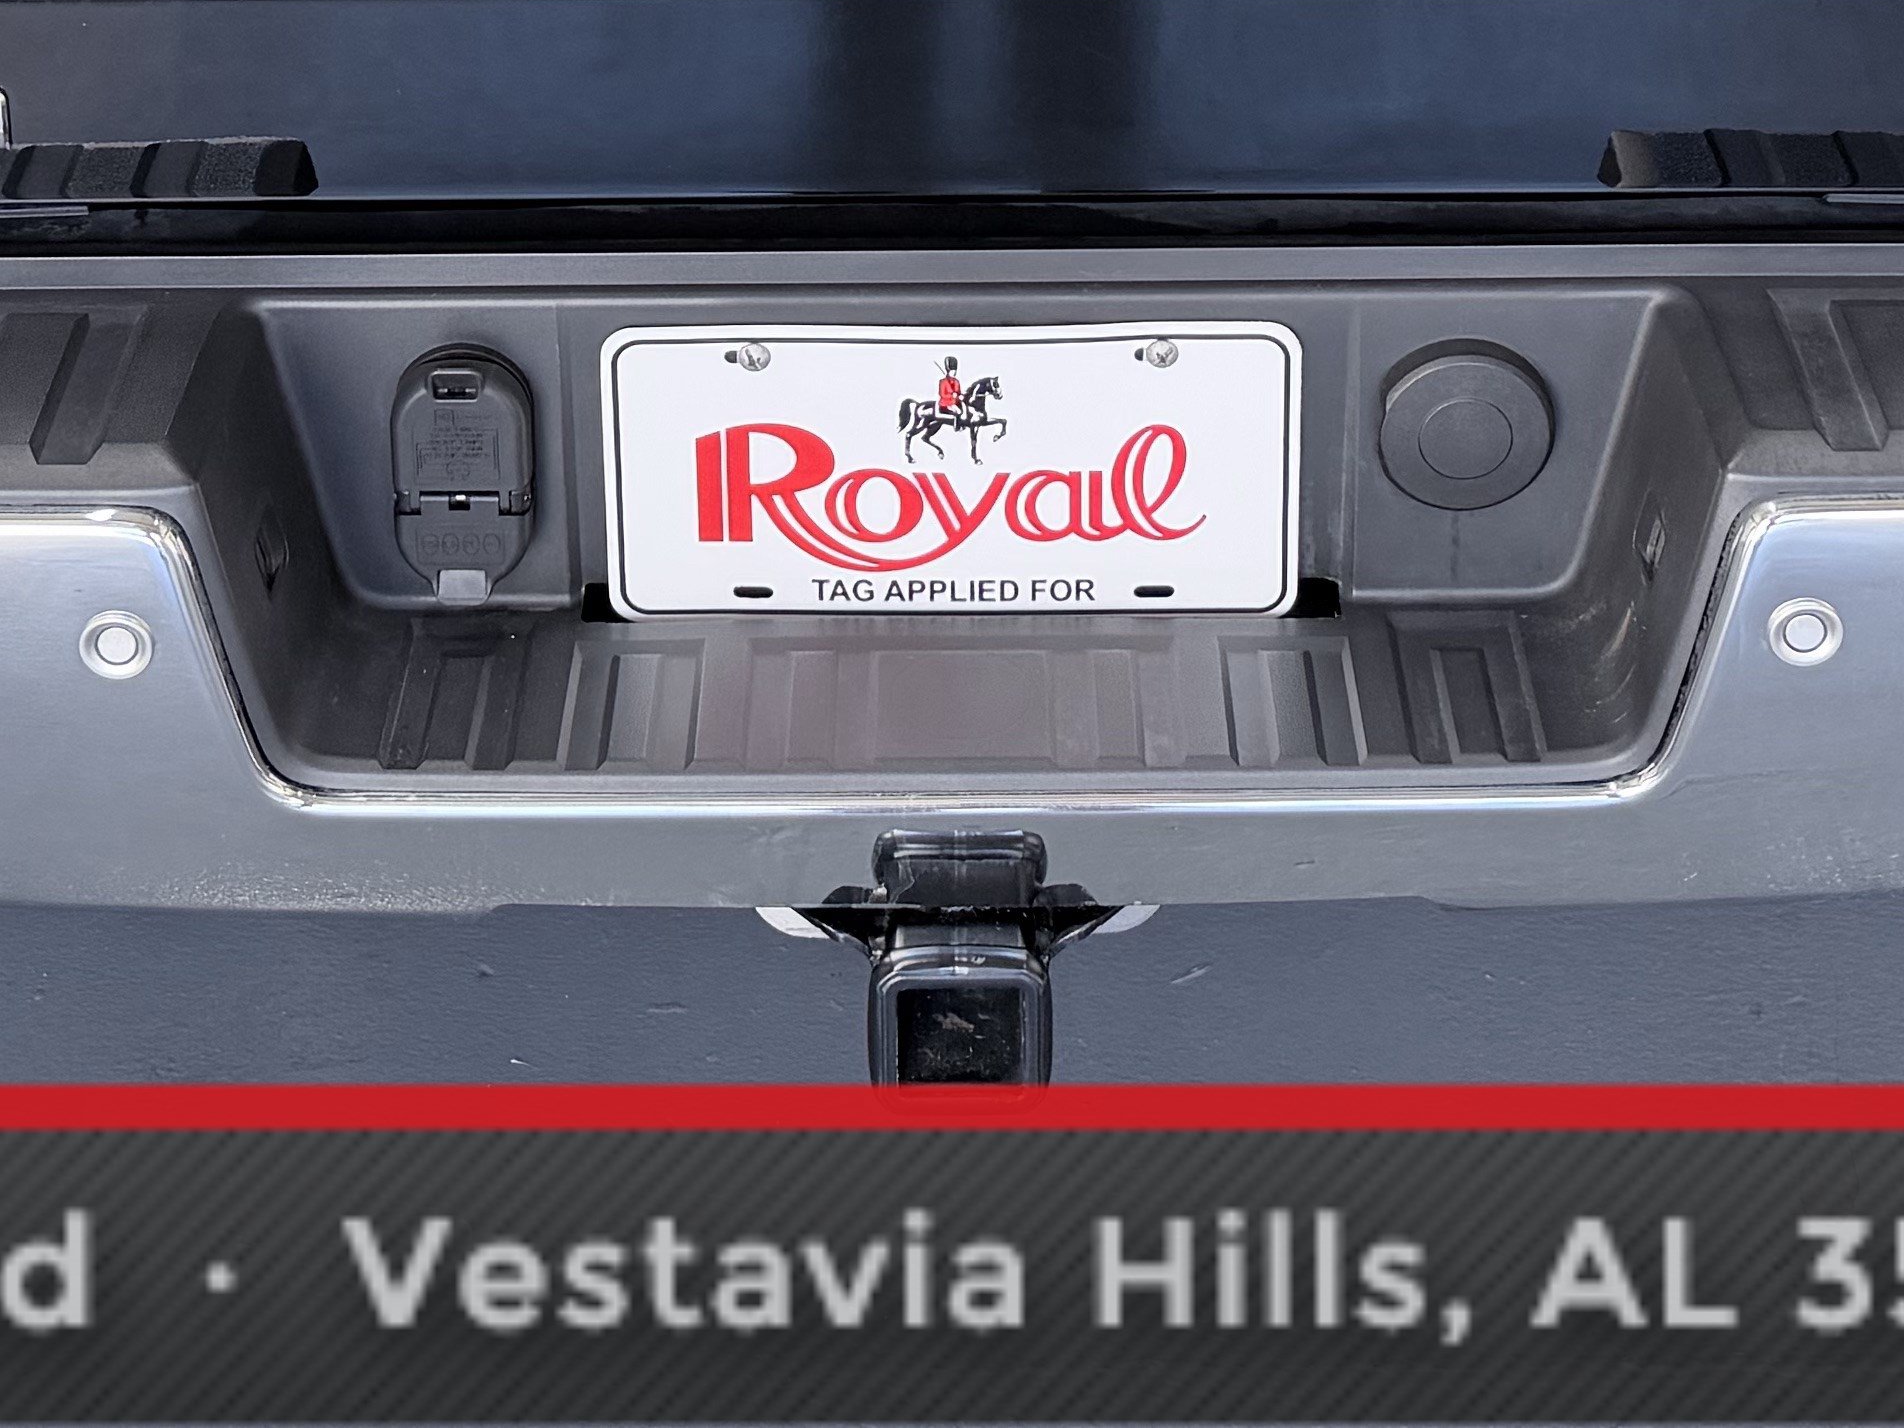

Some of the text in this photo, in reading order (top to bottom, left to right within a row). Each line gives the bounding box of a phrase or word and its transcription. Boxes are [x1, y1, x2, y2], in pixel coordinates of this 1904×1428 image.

[696, 423, 1207, 573] Royal
[811, 579, 1096, 602] TAG APPLIED FOR
